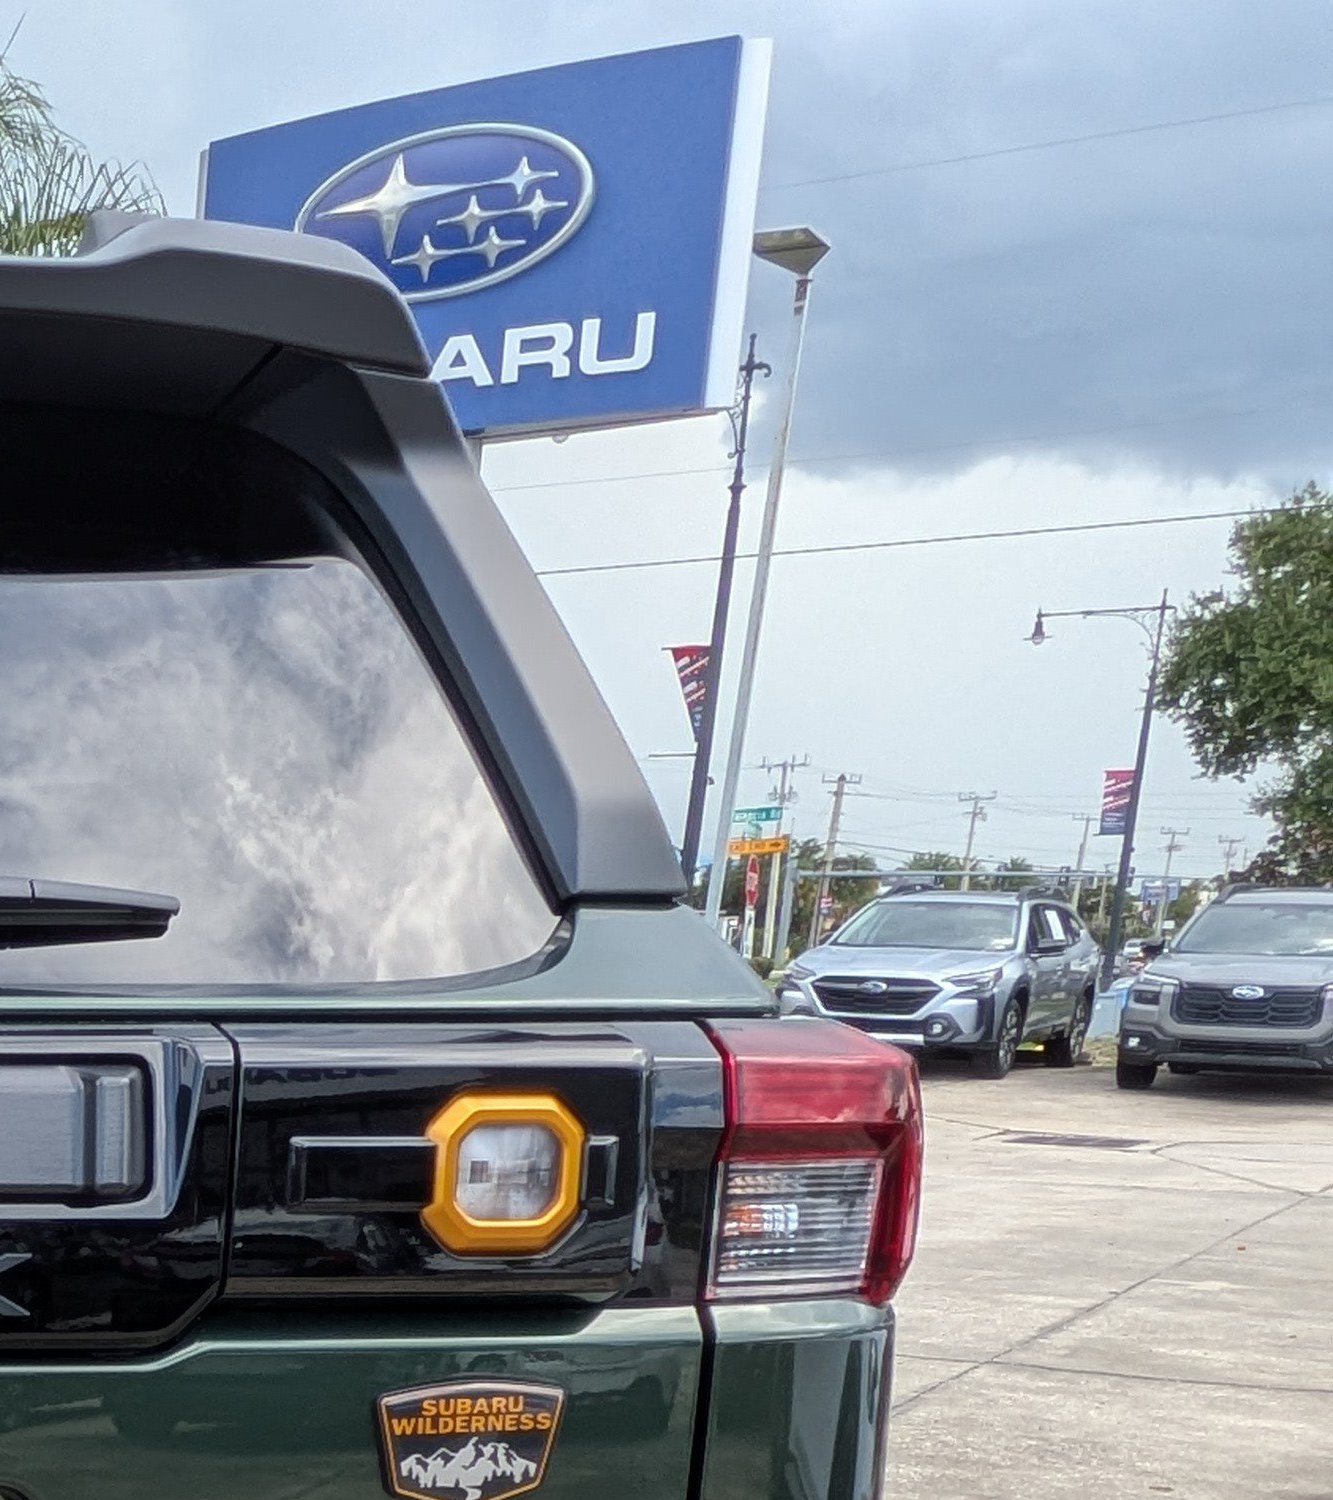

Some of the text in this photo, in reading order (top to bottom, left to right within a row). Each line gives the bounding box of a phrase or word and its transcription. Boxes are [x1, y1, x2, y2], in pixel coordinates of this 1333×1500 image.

[433, 311, 656, 388] ARU
[421, 1395, 524, 1416] SUBARU
[391, 1412, 552, 1436] WILDERNESS
